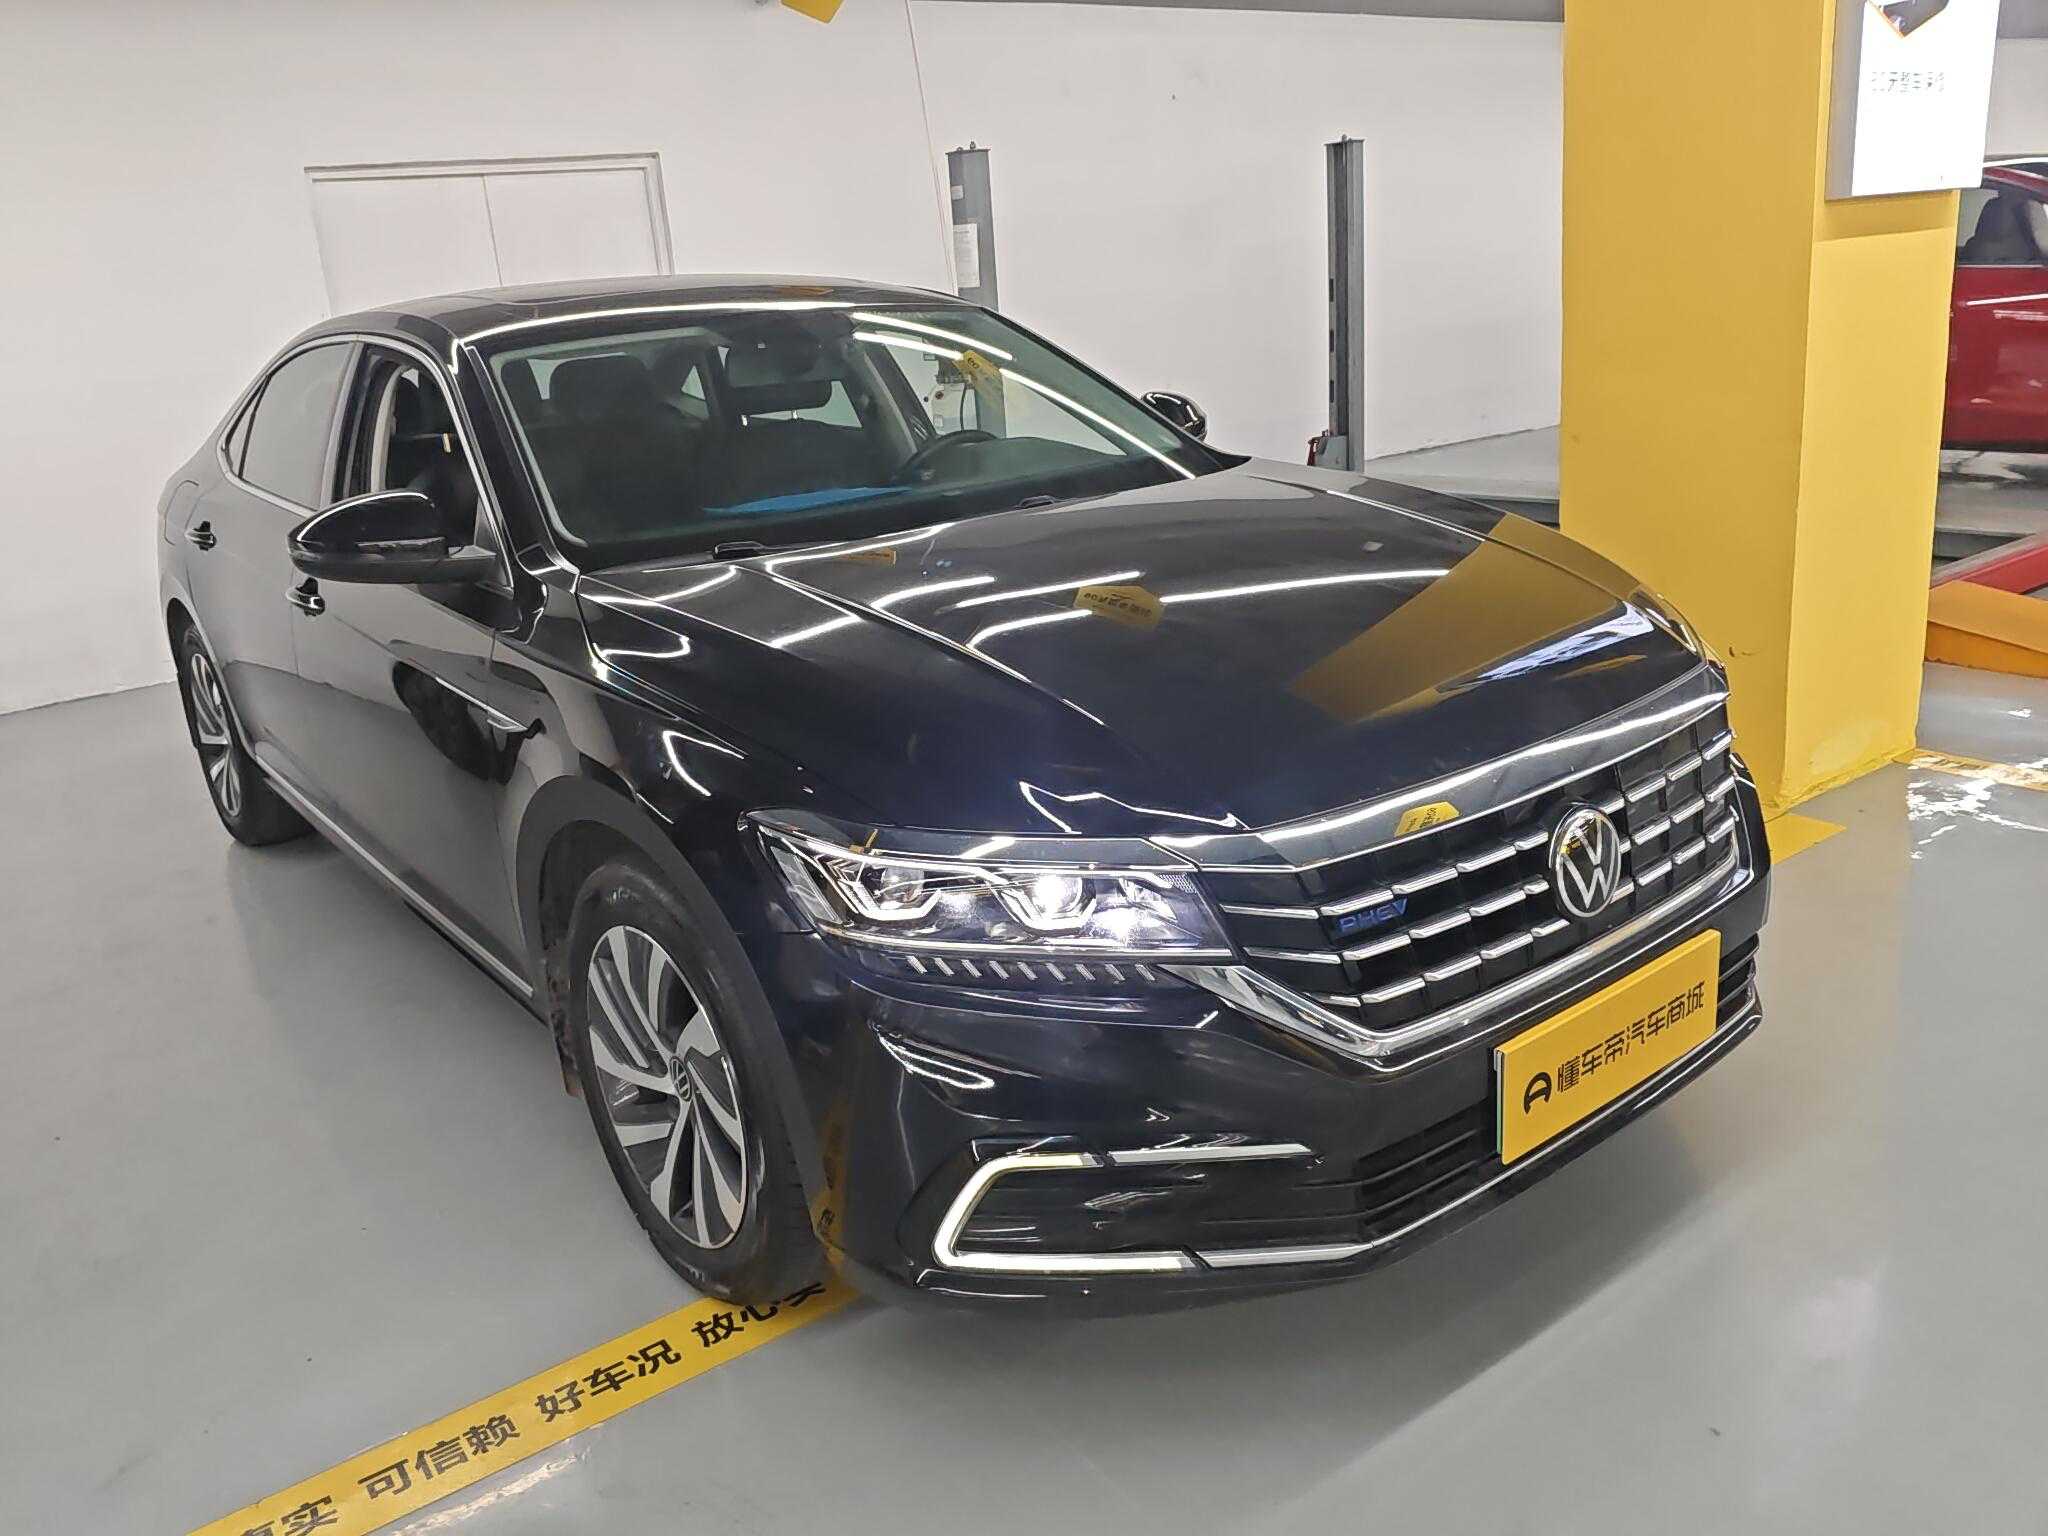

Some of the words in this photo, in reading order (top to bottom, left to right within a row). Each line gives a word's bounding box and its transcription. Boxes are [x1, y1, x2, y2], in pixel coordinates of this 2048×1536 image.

[1556, 981, 1704, 1093] 懂车帝汽车商城
[358, 1413, 521, 1500] 可信赖
[535, 1338, 682, 1424] 好车况
